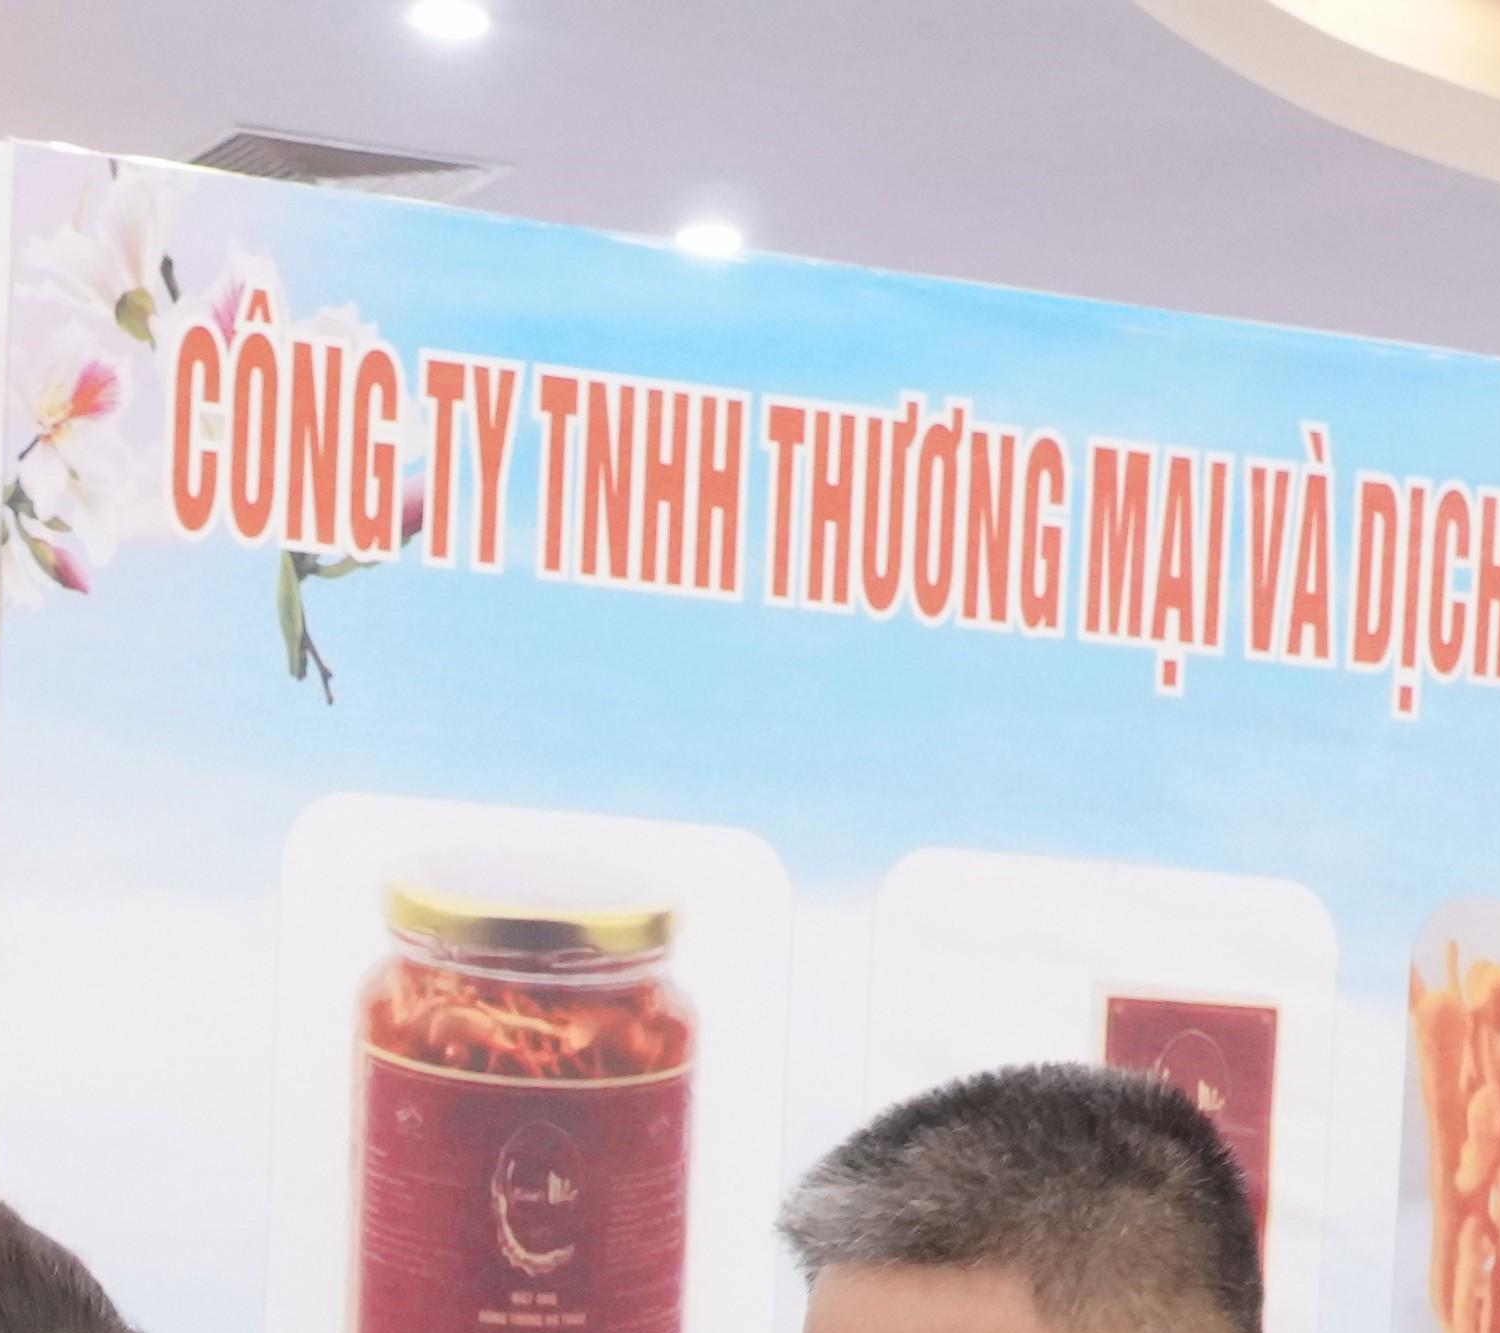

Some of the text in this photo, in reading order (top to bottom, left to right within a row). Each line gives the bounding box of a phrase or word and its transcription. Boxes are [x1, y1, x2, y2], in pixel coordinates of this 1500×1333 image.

[170, 286, 401, 552] CÔNG
[422, 359, 516, 565] TY
[537, 374, 744, 593] TNHH
[766, 399, 1065, 630] THƯƠNG
[1083, 442, 1229, 691] MẠI
[1247, 427, 1331, 661] VÀ
